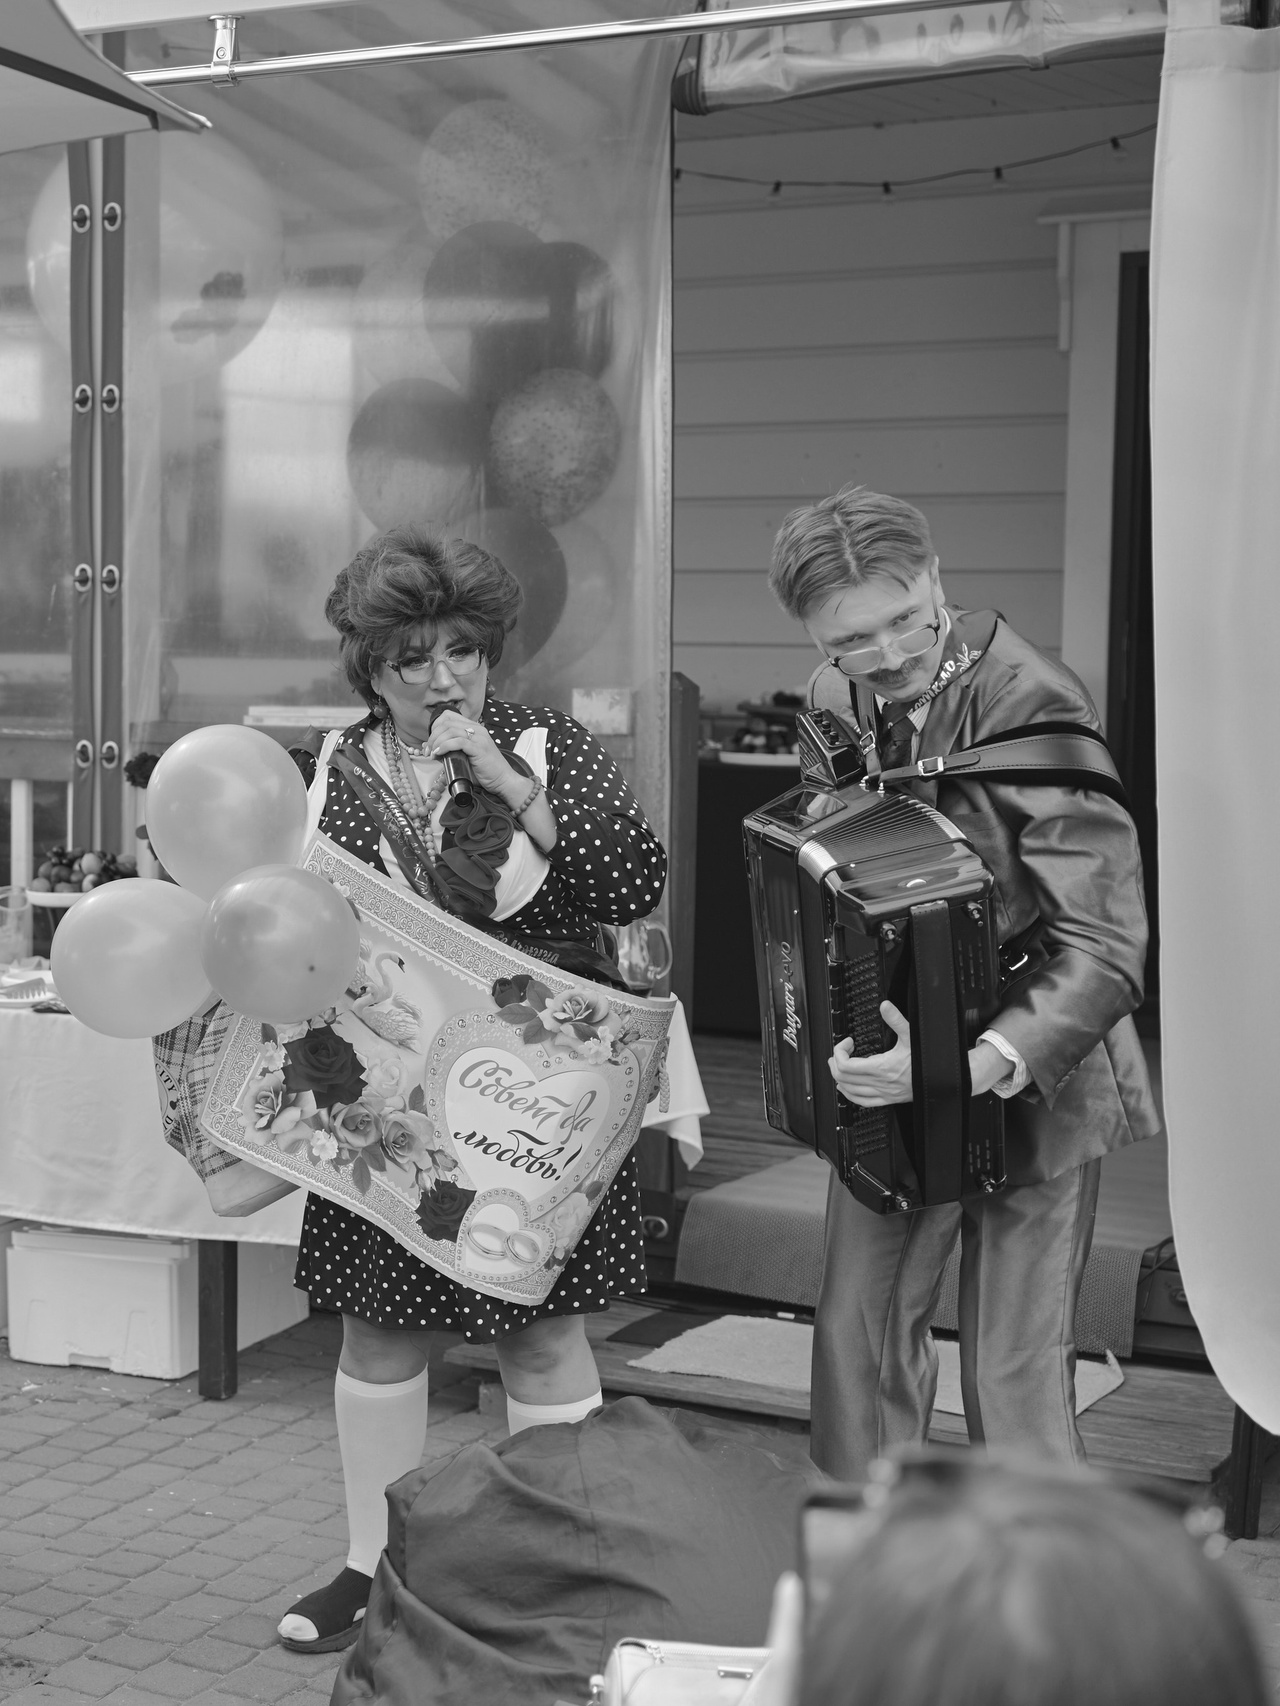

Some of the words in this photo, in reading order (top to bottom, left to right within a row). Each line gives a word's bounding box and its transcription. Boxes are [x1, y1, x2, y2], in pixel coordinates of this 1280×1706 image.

[780, 979, 802, 1053] Bugari
[459, 1060, 572, 1130] Совет
[560, 1090, 597, 1145] да
[453, 1129, 583, 1181] любовь!
